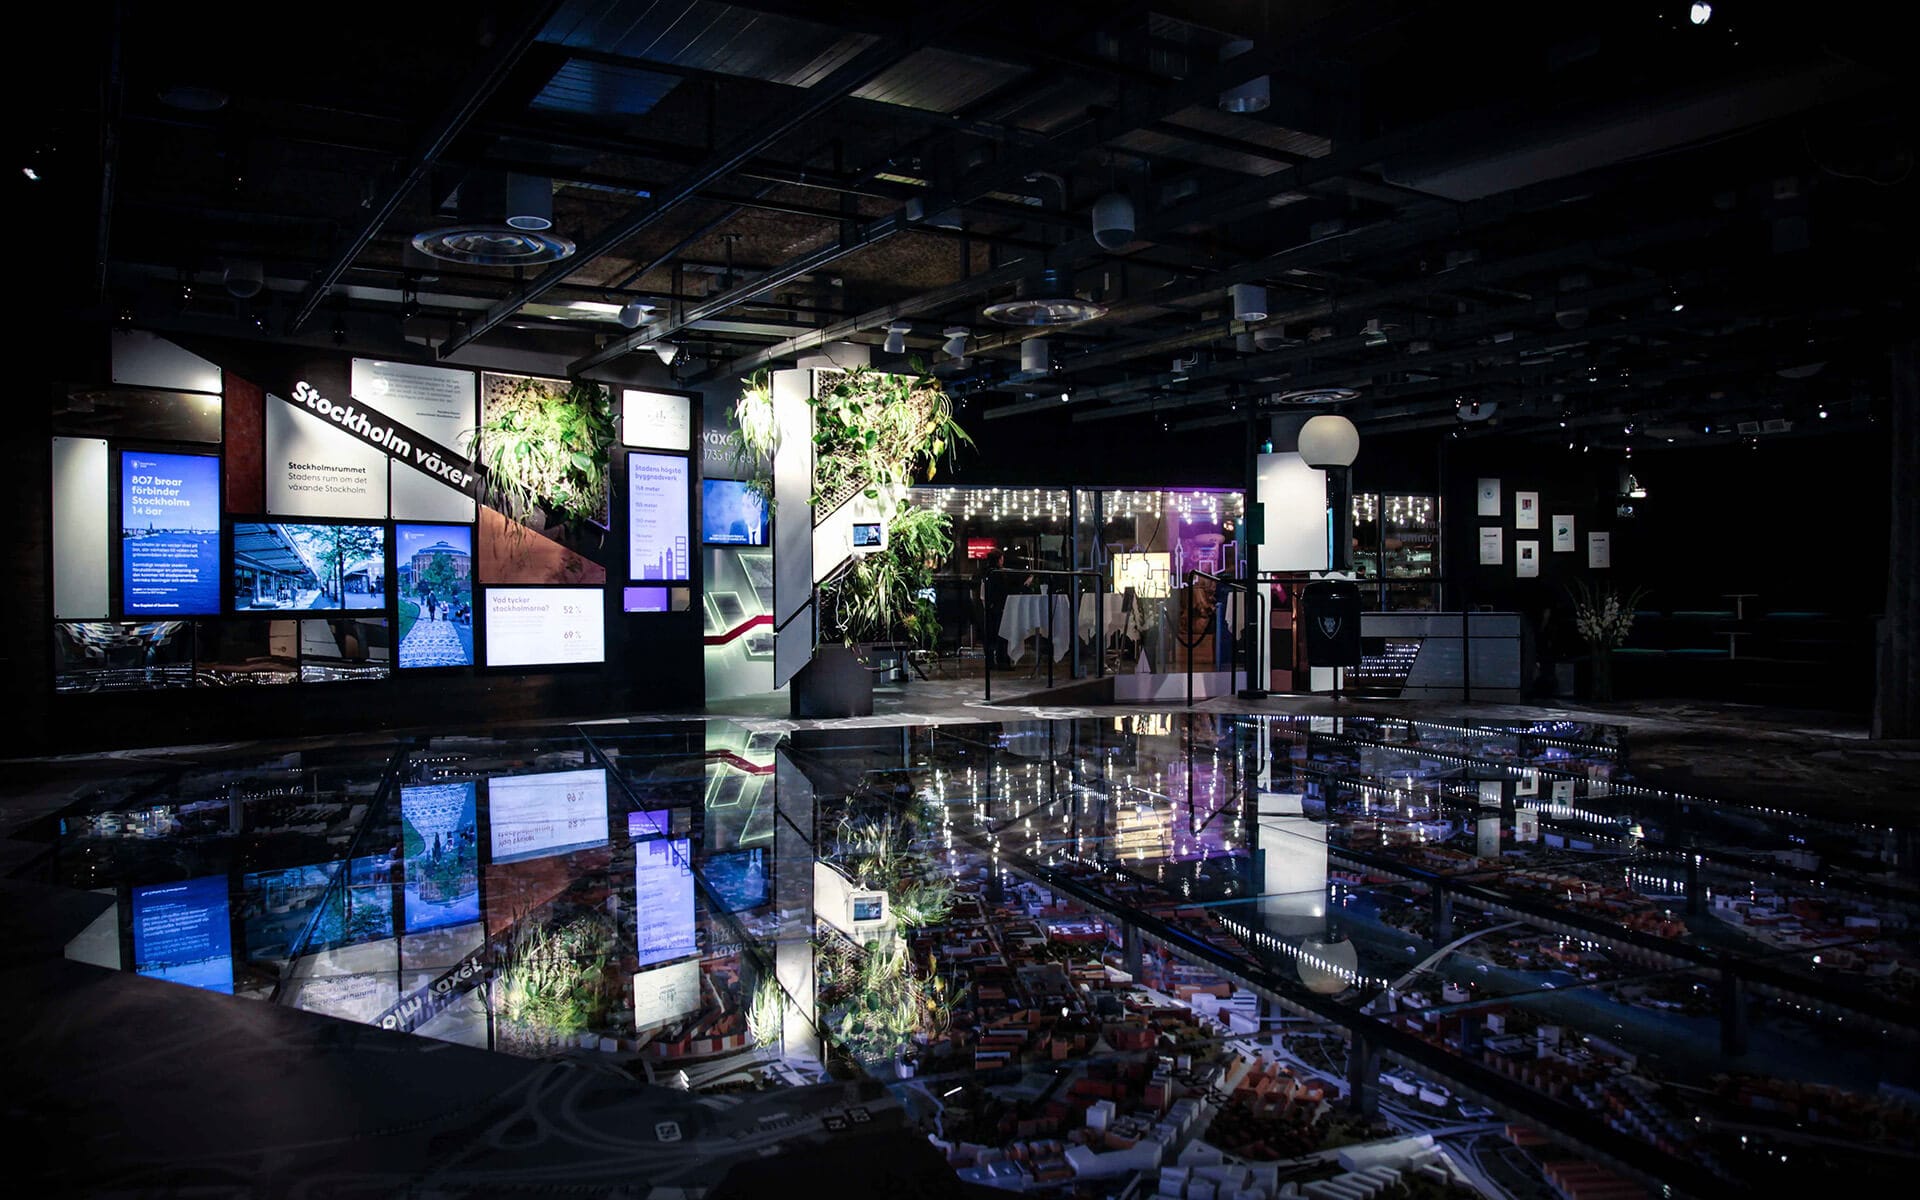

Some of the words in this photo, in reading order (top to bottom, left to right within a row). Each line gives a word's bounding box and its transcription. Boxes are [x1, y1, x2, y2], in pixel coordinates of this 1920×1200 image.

[292, 381, 411, 457] Stockholm
[288, 462, 366, 473] Stockholmsrummet
[131, 475, 153, 484] 807
[154, 477, 182, 486] broar
[288, 472, 320, 481] Stadens
[131, 486, 179, 496] förbinder
[325, 485, 366, 494] Stockholm
[131, 496, 191, 507] Stockholms
[132, 506, 143, 515] 14
[507, 597, 530, 605] tycker
[563, 606, 574, 614] 52
[564, 631, 574, 639] 69
